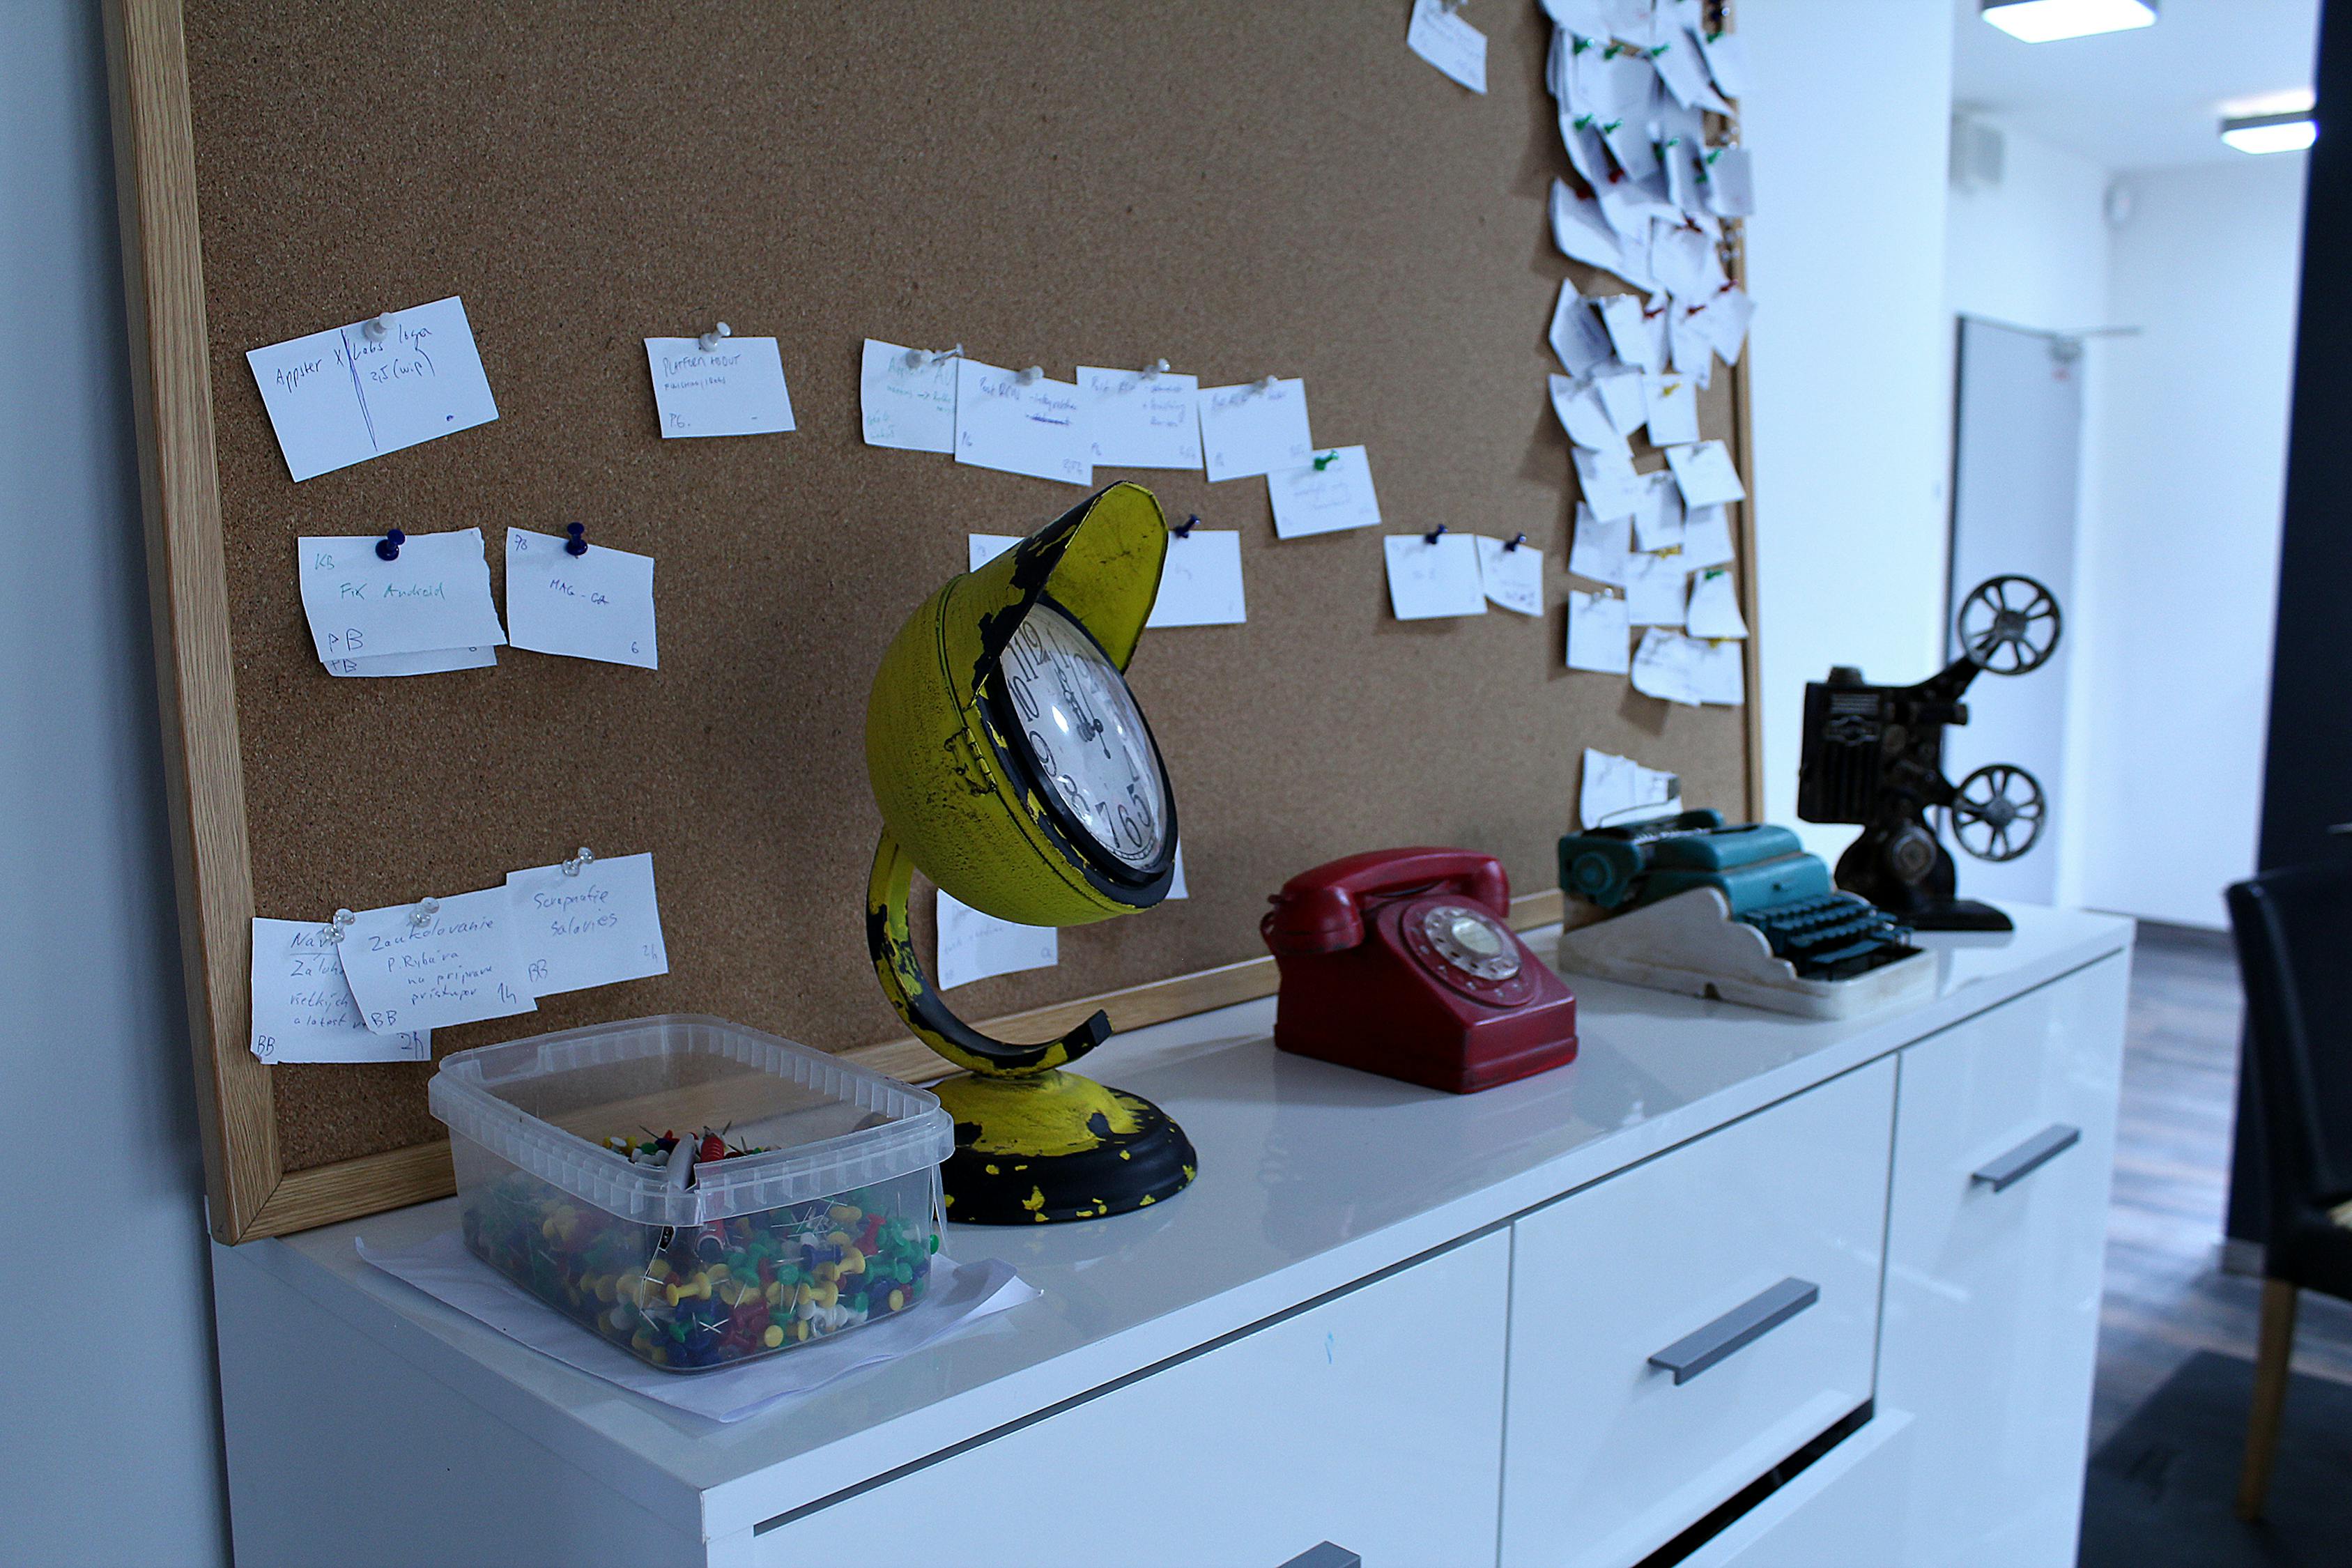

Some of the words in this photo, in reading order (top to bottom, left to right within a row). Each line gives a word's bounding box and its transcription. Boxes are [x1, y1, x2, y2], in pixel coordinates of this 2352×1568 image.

[383, 582, 446, 601] Android
[631, 641, 639, 654] 6
[1029, 730, 1057, 778] 9
[1095, 801, 1121, 849] 7
[1118, 804, 1143, 848] 6
[1126, 783, 1151, 828] 5
